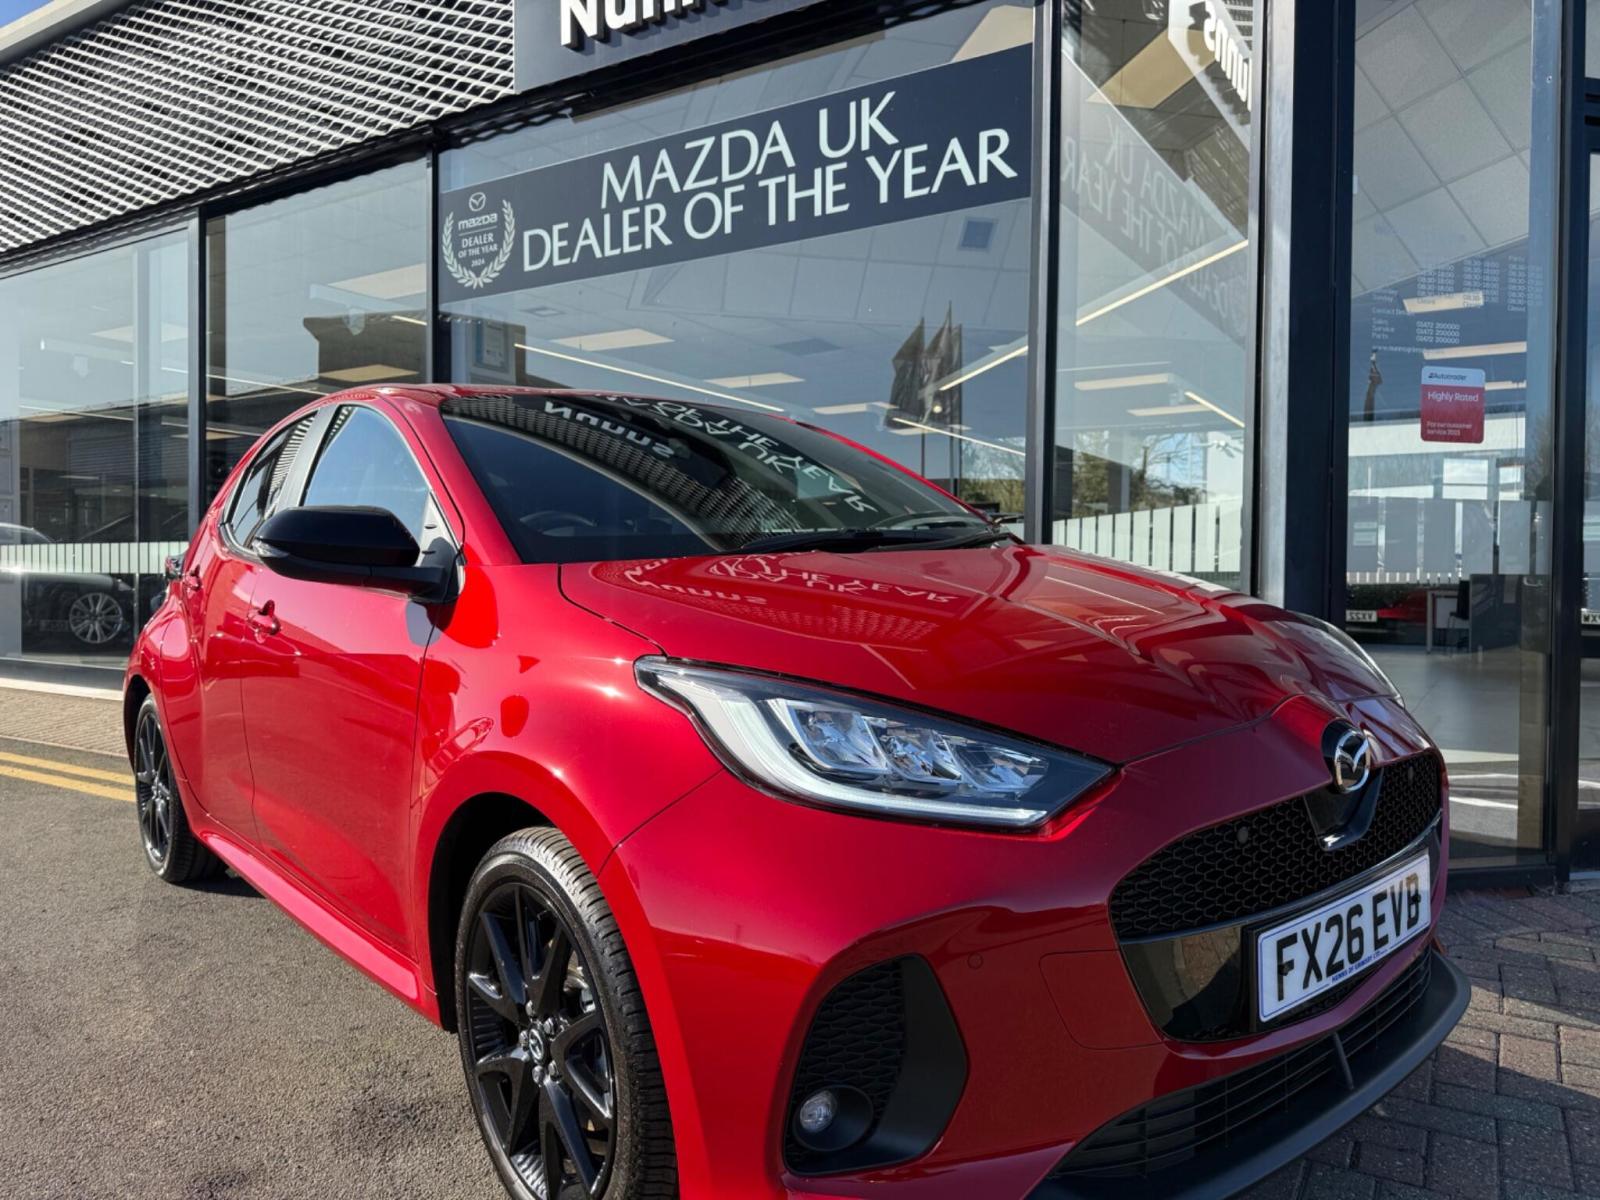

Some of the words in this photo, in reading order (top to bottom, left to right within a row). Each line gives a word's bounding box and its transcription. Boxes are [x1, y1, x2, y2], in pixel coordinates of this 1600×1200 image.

[560, 0, 695, 46] Nu
[601, 120, 796, 209] MAZDA
[819, 90, 899, 159] UK
[523, 203, 673, 272] DEALER
[683, 184, 745, 240] OF
[757, 162, 850, 226] THE
[865, 128, 1018, 204] YEAR
[458, 213, 498, 230] mazda
[458, 250, 466, 258] OF
[468, 247, 480, 257] THE
[481, 244, 498, 254] YEAR
[462, 233, 494, 248] DEALER
[1428, 391, 1453, 403] Highly
[1455, 392, 1479, 402] Rated
[1276, 903, 1364, 1002] FX26
[1372, 872, 1421, 951] EVB
